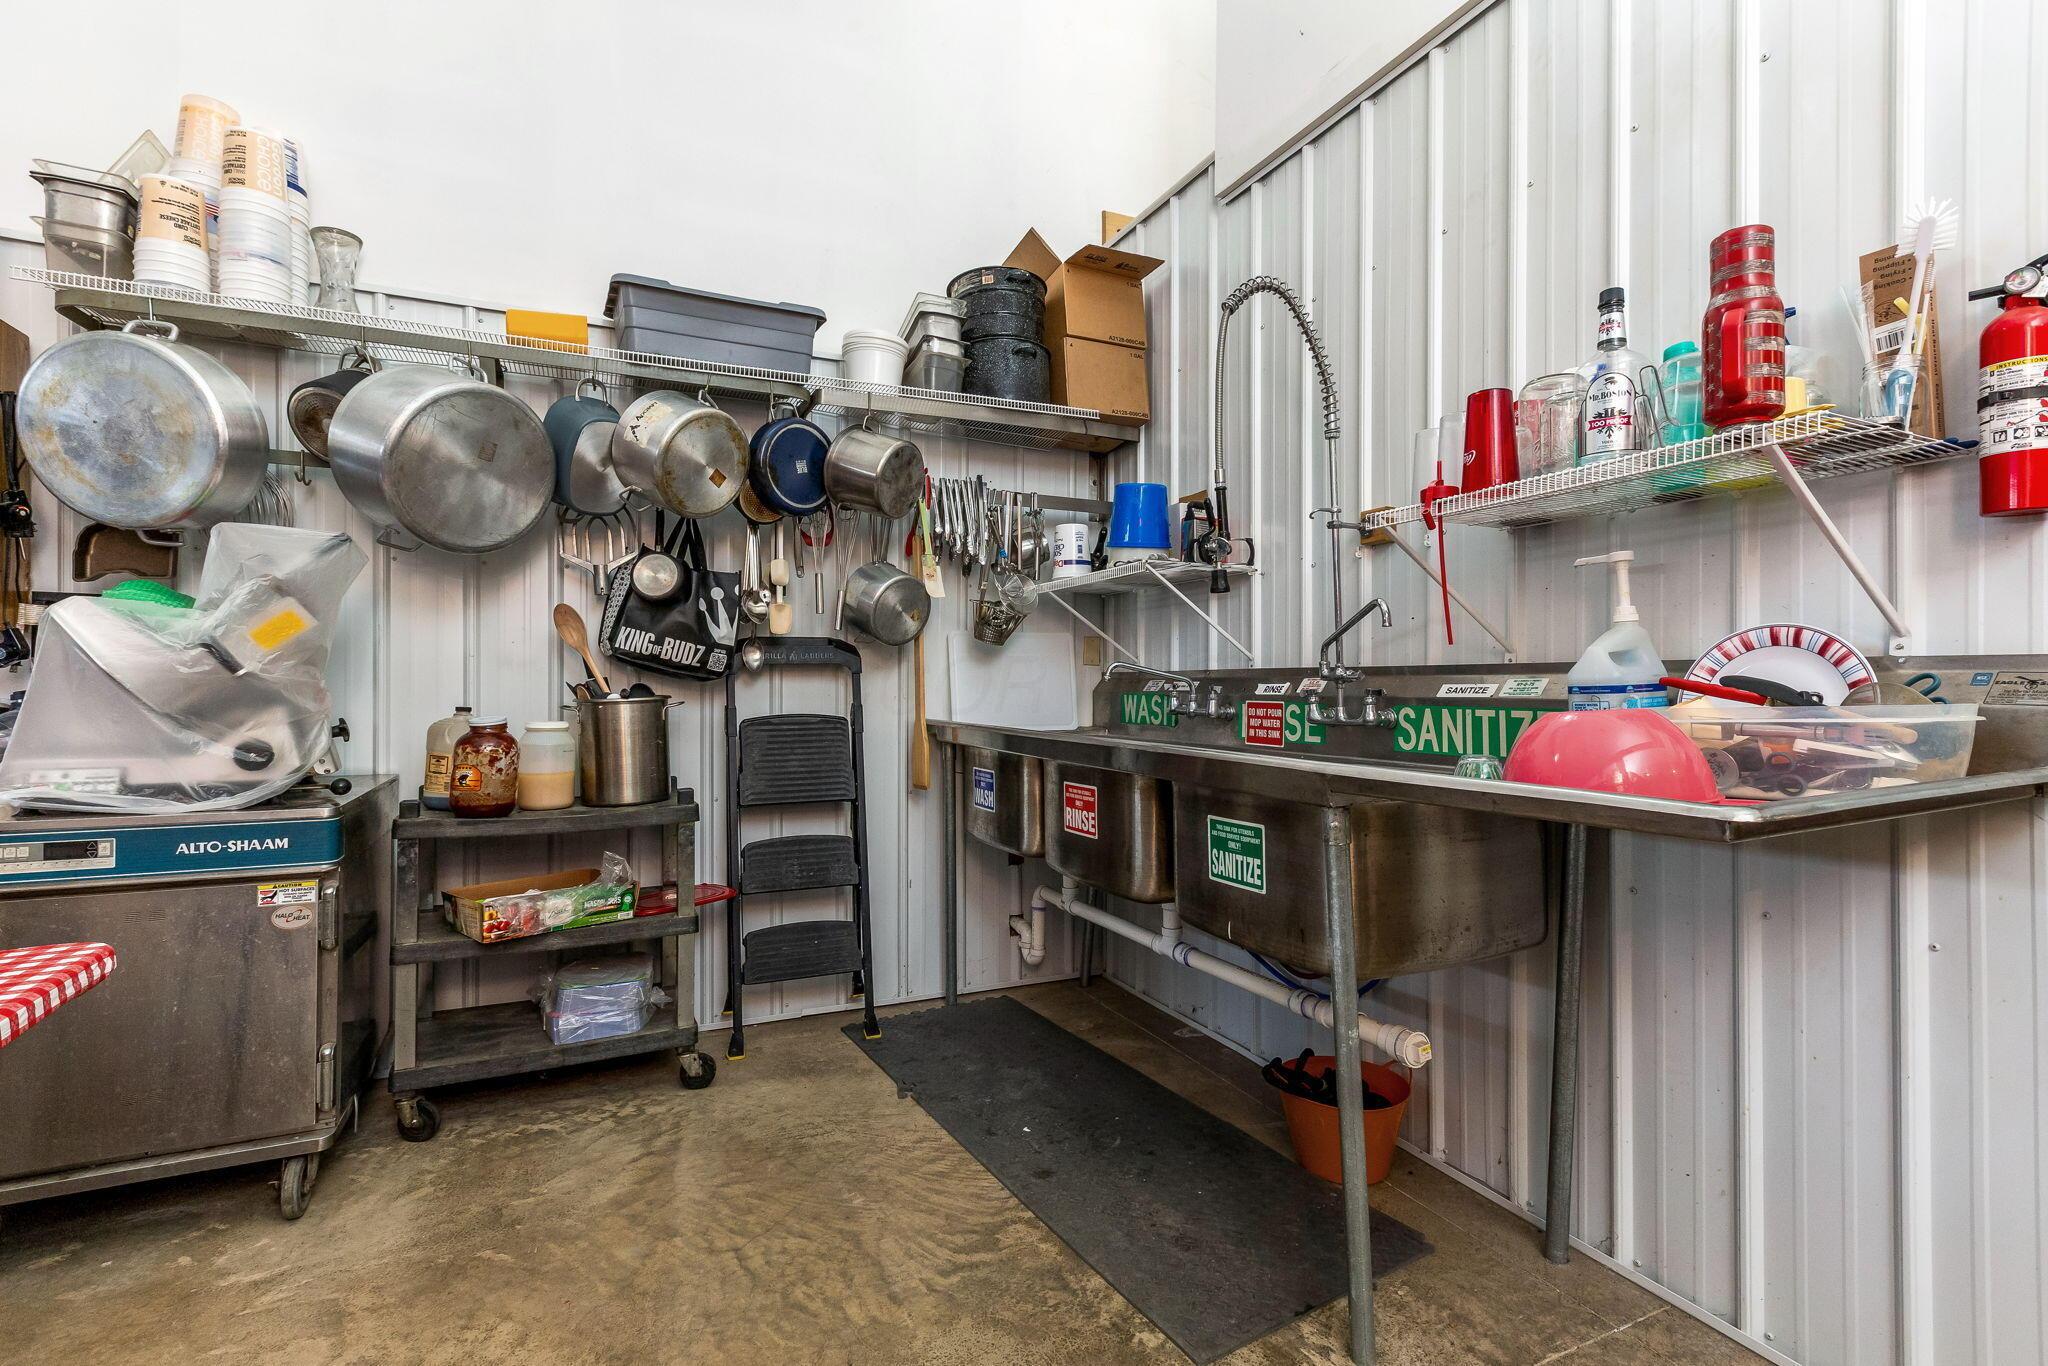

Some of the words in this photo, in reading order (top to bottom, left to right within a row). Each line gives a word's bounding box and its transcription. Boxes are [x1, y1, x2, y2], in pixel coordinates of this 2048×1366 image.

[1872, 259, 1905, 273] Flipping
[1880, 267, 1906, 280] Frying
[1873, 277, 1907, 291] Cooking
[1996, 356, 2048, 369] INSTRUCIONS
[614, 626, 656, 655] KING
[653, 645, 663, 655] OF
[660, 636, 706, 667] BUDZ
[1263, 685, 1285, 693] RINSE
[1445, 686, 1490, 694] SANITIZE
[1123, 694, 1176, 727] WASH
[1248, 707, 1256, 716] DO
[1256, 708, 1266, 717] NOT
[1267, 708, 1282, 718] POUR
[1249, 718, 1262, 727] MOP
[1262, 718, 1281, 728] WATER
[1248, 728, 1255, 737] IN
[1256, 729, 1267, 738] THIS
[1267, 729, 1281, 739] SINK
[1397, 706, 1547, 757] SANITIZ
[975, 787, 994, 808] WASH
[1066, 806, 1096, 833] RINSE
[1226, 832, 1240, 840] SERVICE
[1237, 828, 1255, 837] UTENSILS
[175, 837, 289, 855] ALTO-SHAAM
[1227, 840, 1242, 850] ONLY!
[1211, 848, 1262, 886] SANITIZE
